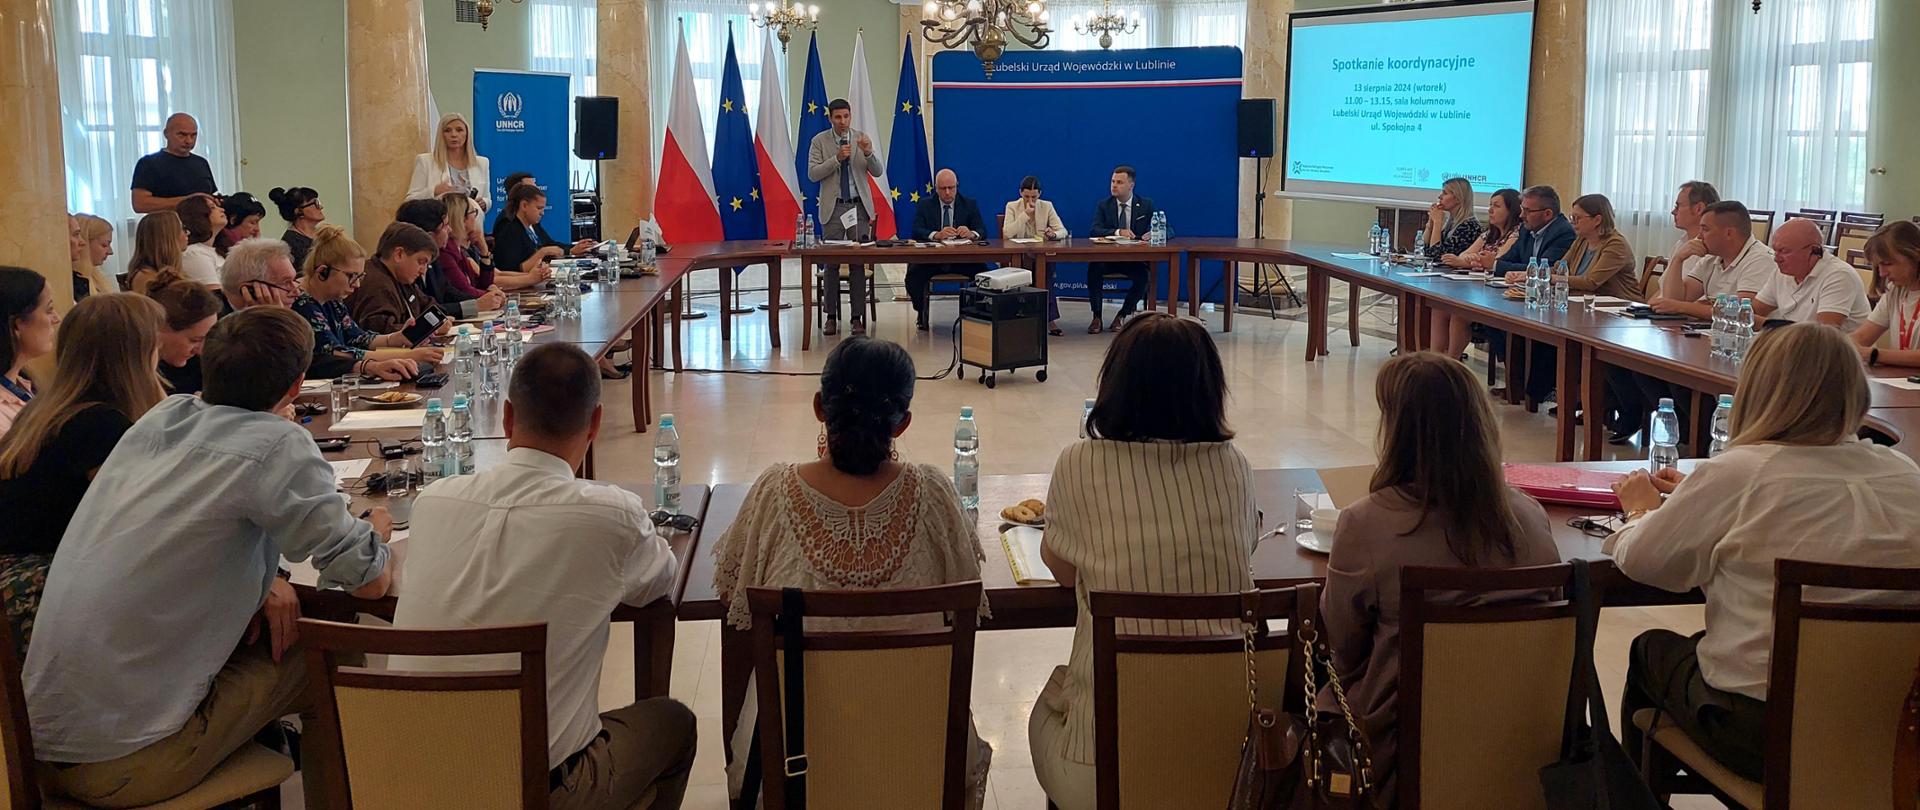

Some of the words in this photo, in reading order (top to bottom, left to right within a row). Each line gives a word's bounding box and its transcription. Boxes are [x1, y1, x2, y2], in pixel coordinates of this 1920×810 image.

[1032, 61, 1060, 73] Urząd
[1062, 60, 1121, 73] Wojewódzki
[1135, 59, 1176, 70] Lublinie
[1332, 58, 1384, 72] Spotkanie
[1387, 55, 1475, 71] koordynacyjne
[1354, 84, 1362, 92] 13
[1363, 84, 1392, 93] sierpnia
[1393, 84, 1411, 92] 2024
[1413, 83, 1446, 93] (wtorek)
[1345, 97, 1363, 105] 11.00
[1370, 97, 1393, 106] 13.15,
[1395, 97, 1409, 105] sala
[1410, 97, 1456, 106] kolumnowa
[1332, 108, 1360, 118] Lubelski
[1361, 109, 1381, 119] Urząd
[1383, 109, 1428, 120] Wojewódzki
[1439, 110, 1471, 119] Lublinie
[496, 120, 525, 129] UNHCR
[1370, 122, 1380, 131] ul.
[1382, 122, 1415, 133] Spokojna
[1416, 123, 1422, 131] 4
